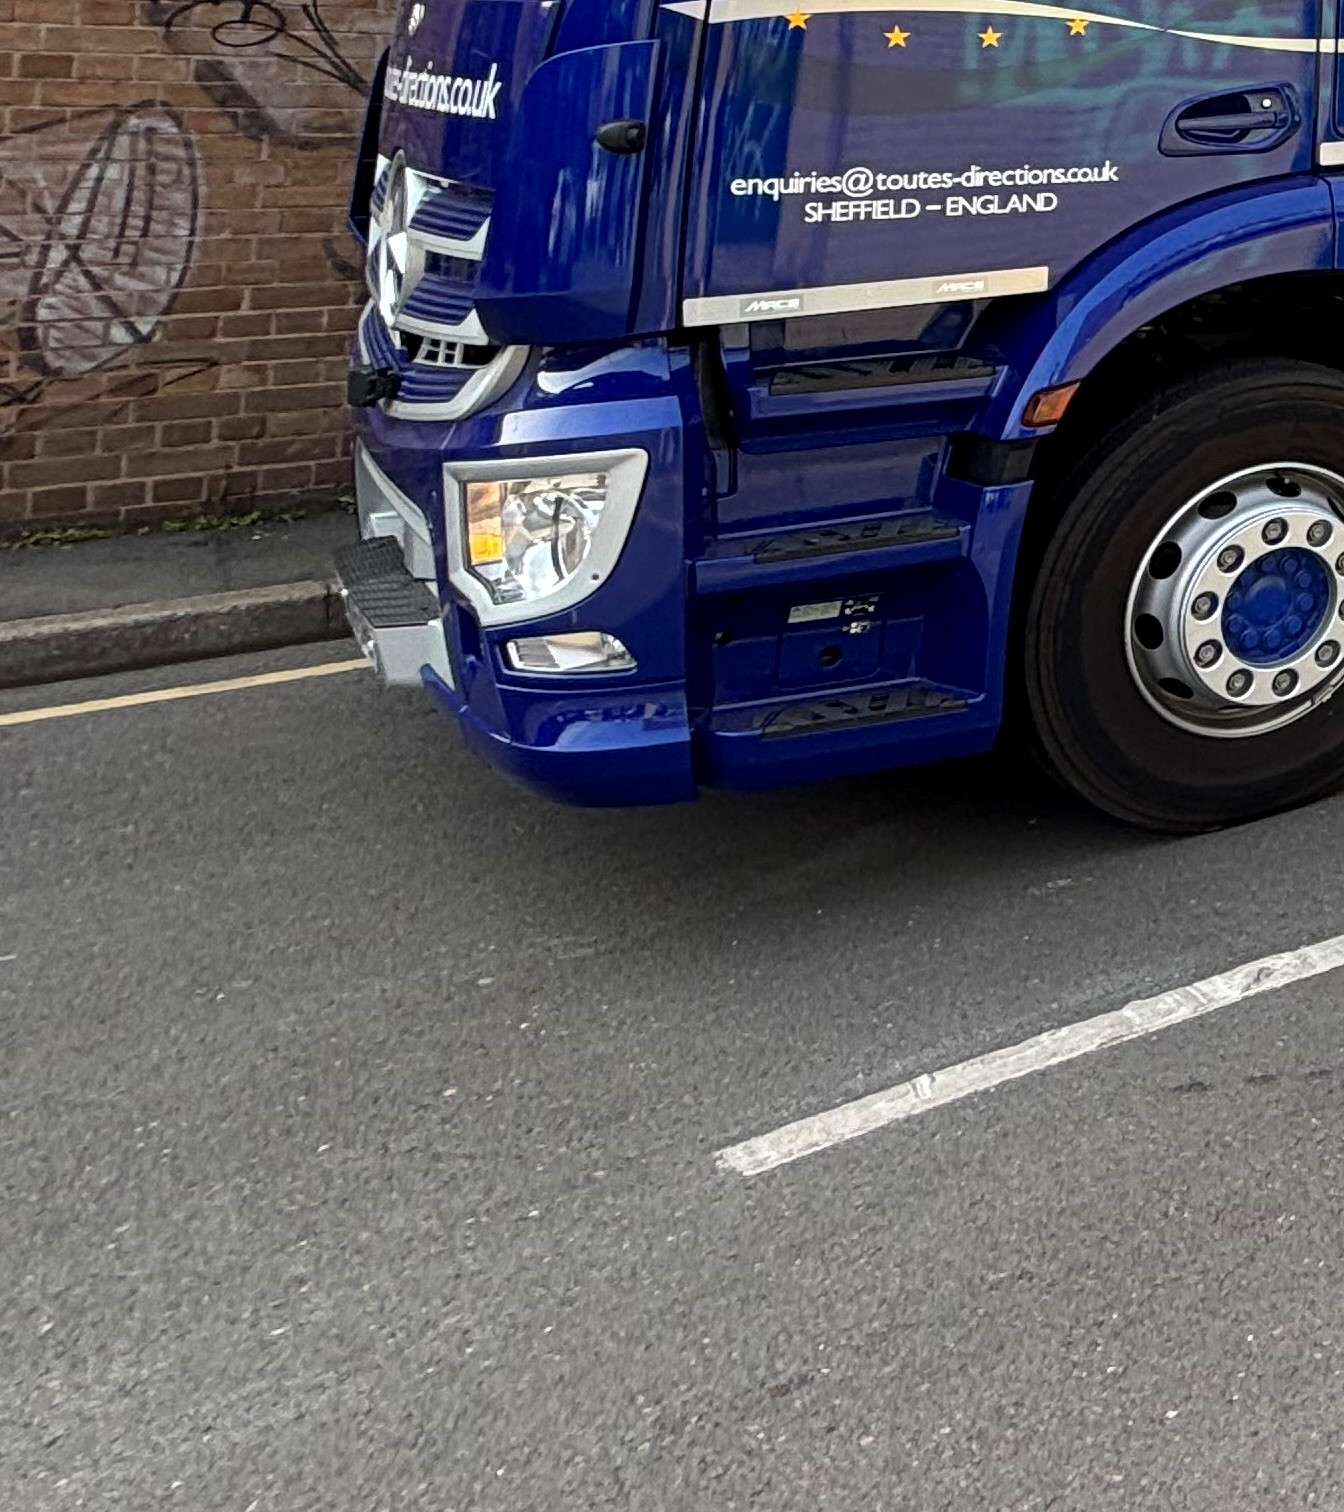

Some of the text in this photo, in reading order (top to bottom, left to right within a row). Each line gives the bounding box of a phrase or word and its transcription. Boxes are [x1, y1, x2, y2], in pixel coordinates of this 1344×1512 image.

[730, 160, 1120, 201] enquiries@toutes-directions.co.uk
[804, 198, 921, 223] SHEFFIELD
[946, 192, 1058, 217] ENGLAND
